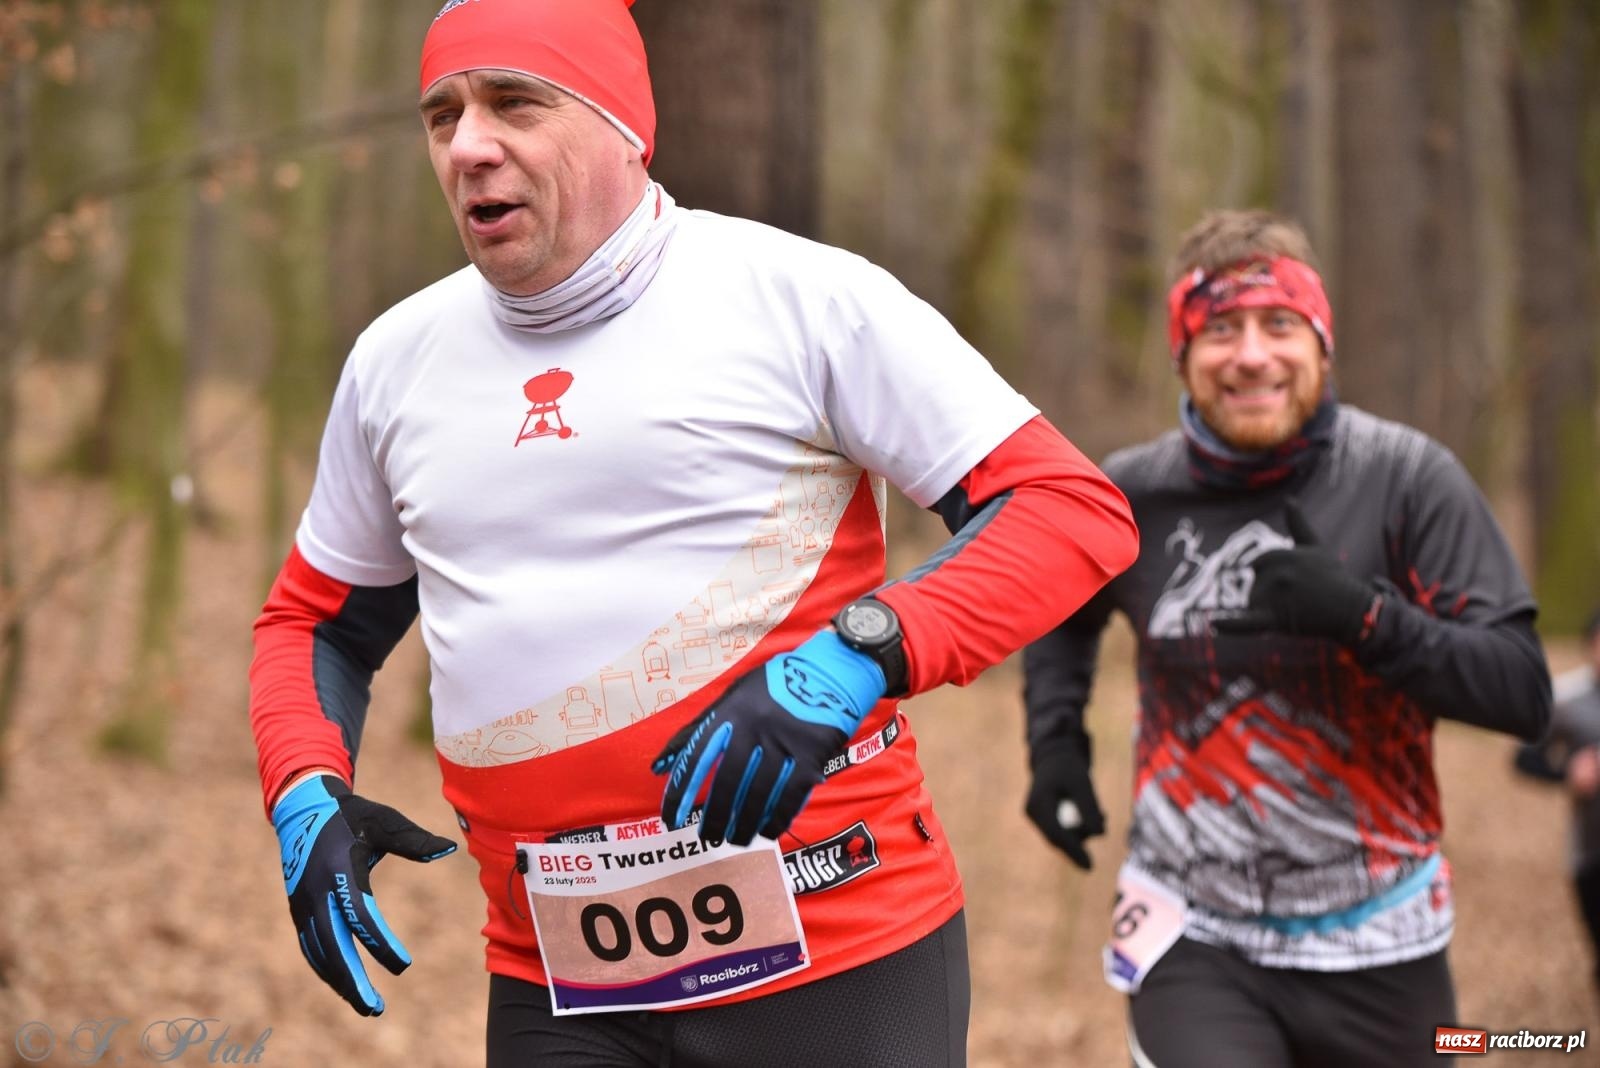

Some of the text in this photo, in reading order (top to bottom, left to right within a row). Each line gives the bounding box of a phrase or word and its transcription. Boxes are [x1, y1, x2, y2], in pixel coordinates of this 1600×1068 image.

[823, 754, 847, 775] EBER
[856, 735, 882, 761] ACTIVE
[616, 820, 662, 840] ACTIVE
[538, 854, 593, 873] BIEG
[784, 844, 844, 894] eber
[544, 876, 597, 887] 23 luty 2025
[335, 873, 379, 948] DYNAFIT
[580, 884, 744, 962] 009
[700, 962, 759, 985] Racibórz
